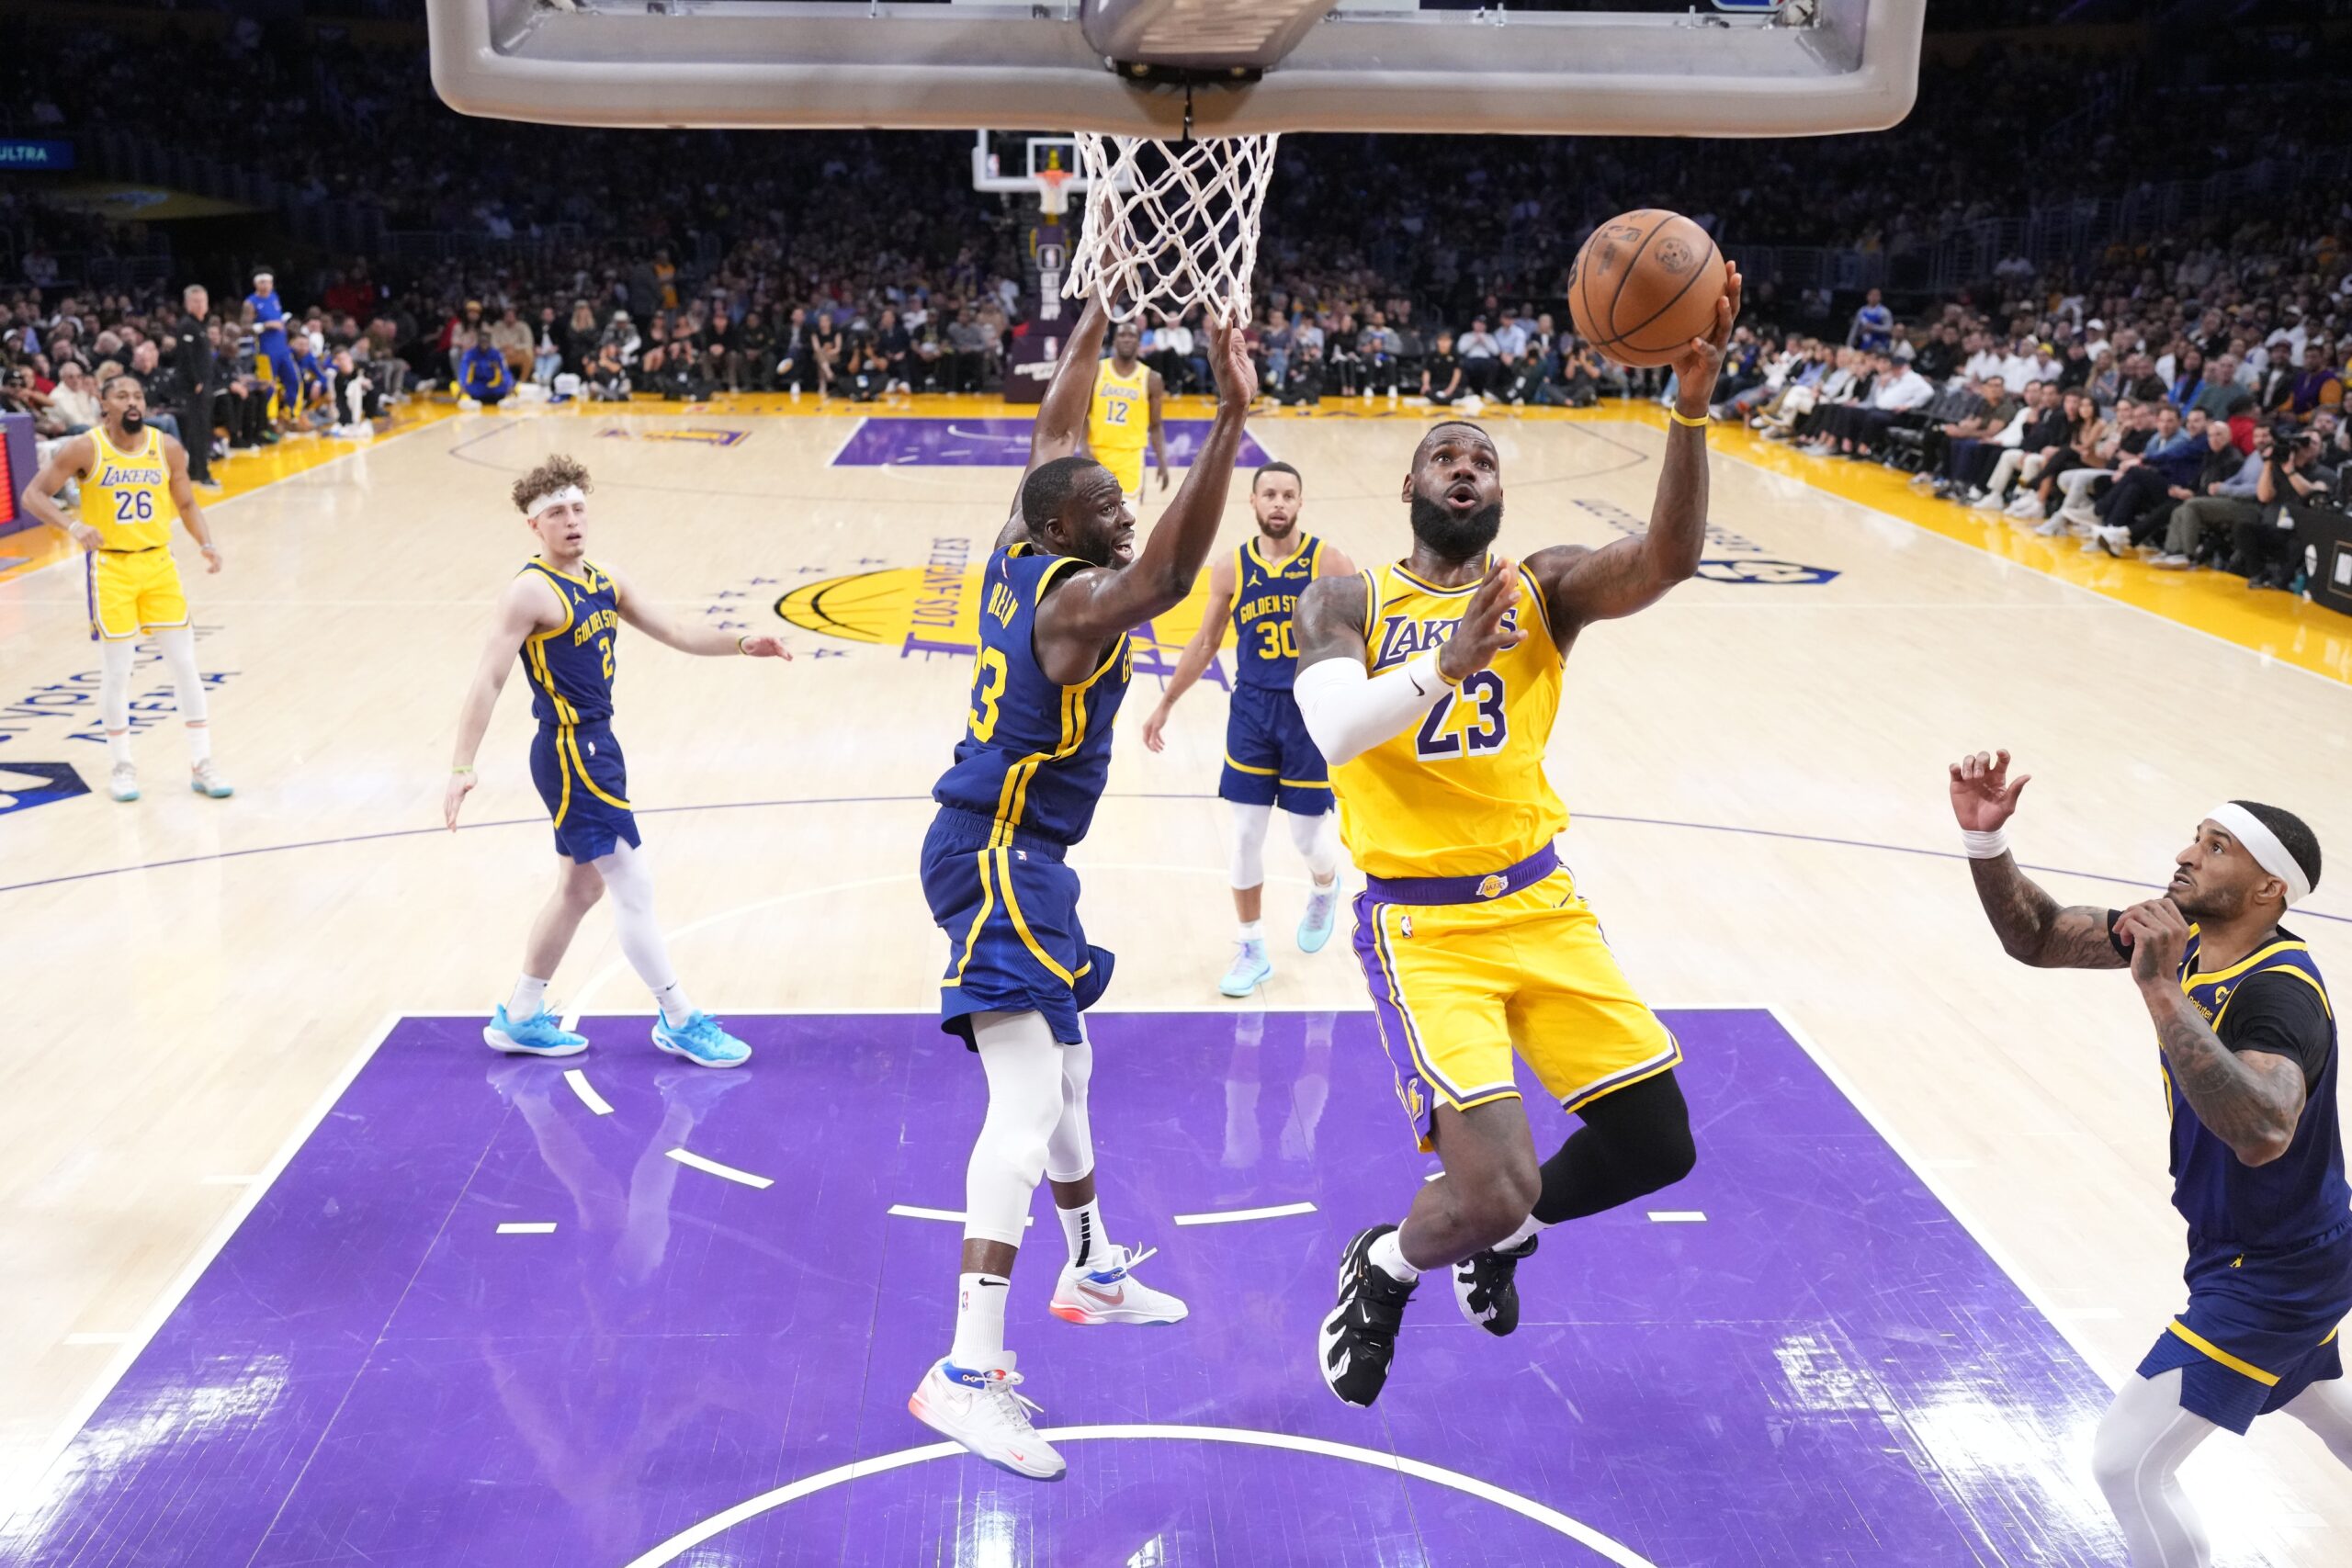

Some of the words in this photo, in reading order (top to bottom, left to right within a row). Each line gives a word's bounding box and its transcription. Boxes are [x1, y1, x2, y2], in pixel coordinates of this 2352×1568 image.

[1106, 400, 1128, 423] 12
[98, 466, 163, 487] LAKERS
[115, 490, 153, 522] 26
[922, 537, 970, 597] ANGELES
[911, 597, 959, 628] LOS
[987, 581, 1020, 630] REEN
[1240, 594, 1281, 625] GOLDEN
[598, 637, 614, 680] 2
[1256, 620, 1300, 660] 30
[1373, 607, 1519, 672] LAKS
[1415, 669, 1509, 761] 23
